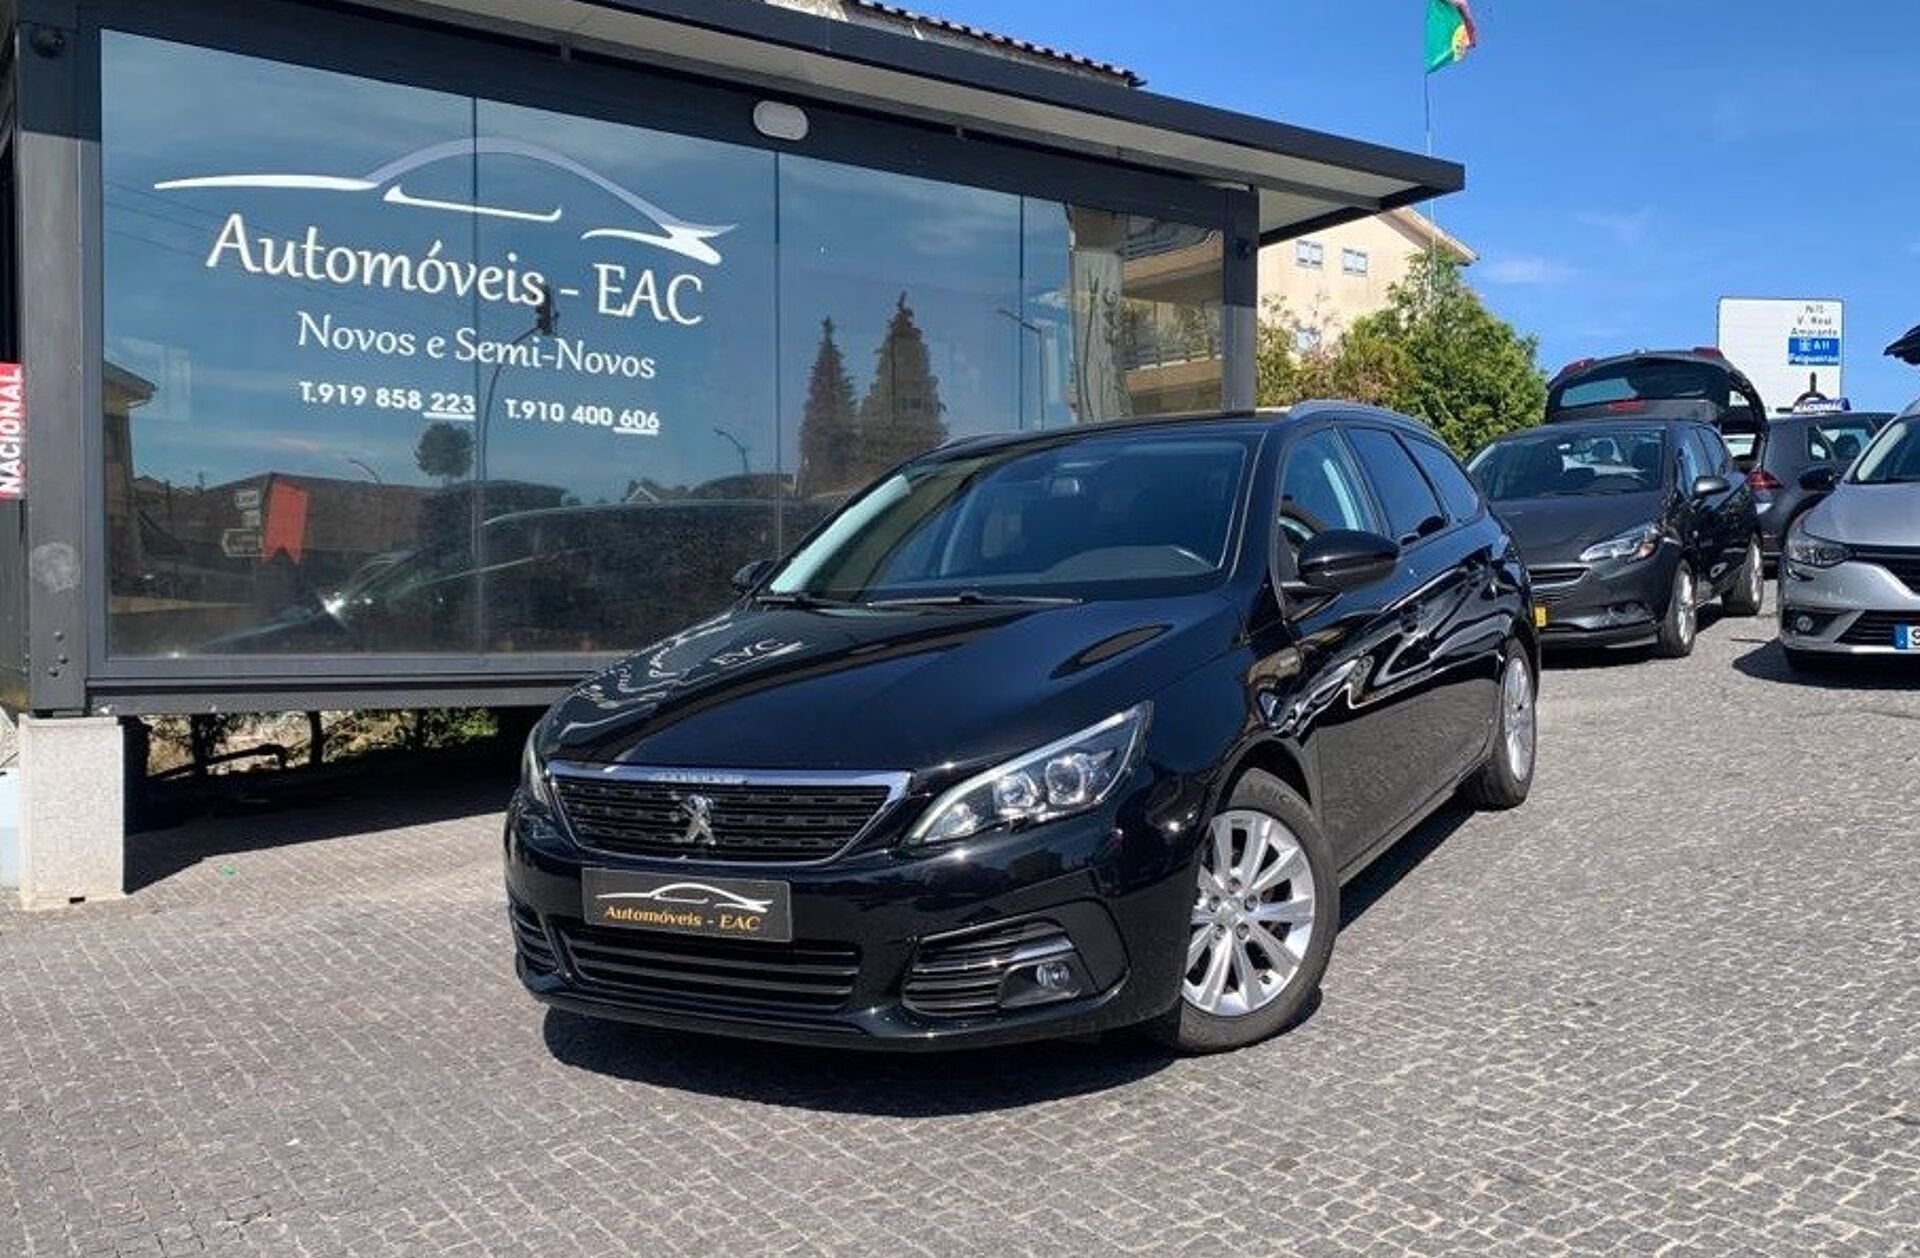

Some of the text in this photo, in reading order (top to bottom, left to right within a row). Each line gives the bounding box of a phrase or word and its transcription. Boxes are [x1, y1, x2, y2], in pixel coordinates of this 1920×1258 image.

[206, 213, 545, 306] Automóveis
[594, 263, 703, 325] EAC
[297, 311, 656, 379] Novos e Semi-Novos
[299, 381, 476, 417] T.919 858 223
[505, 399, 660, 432] T.910 400 606
[0, 366, 21, 495] NACIONAL
[604, 905, 702, 927] Automóveis
[719, 913, 761, 931] EAC
